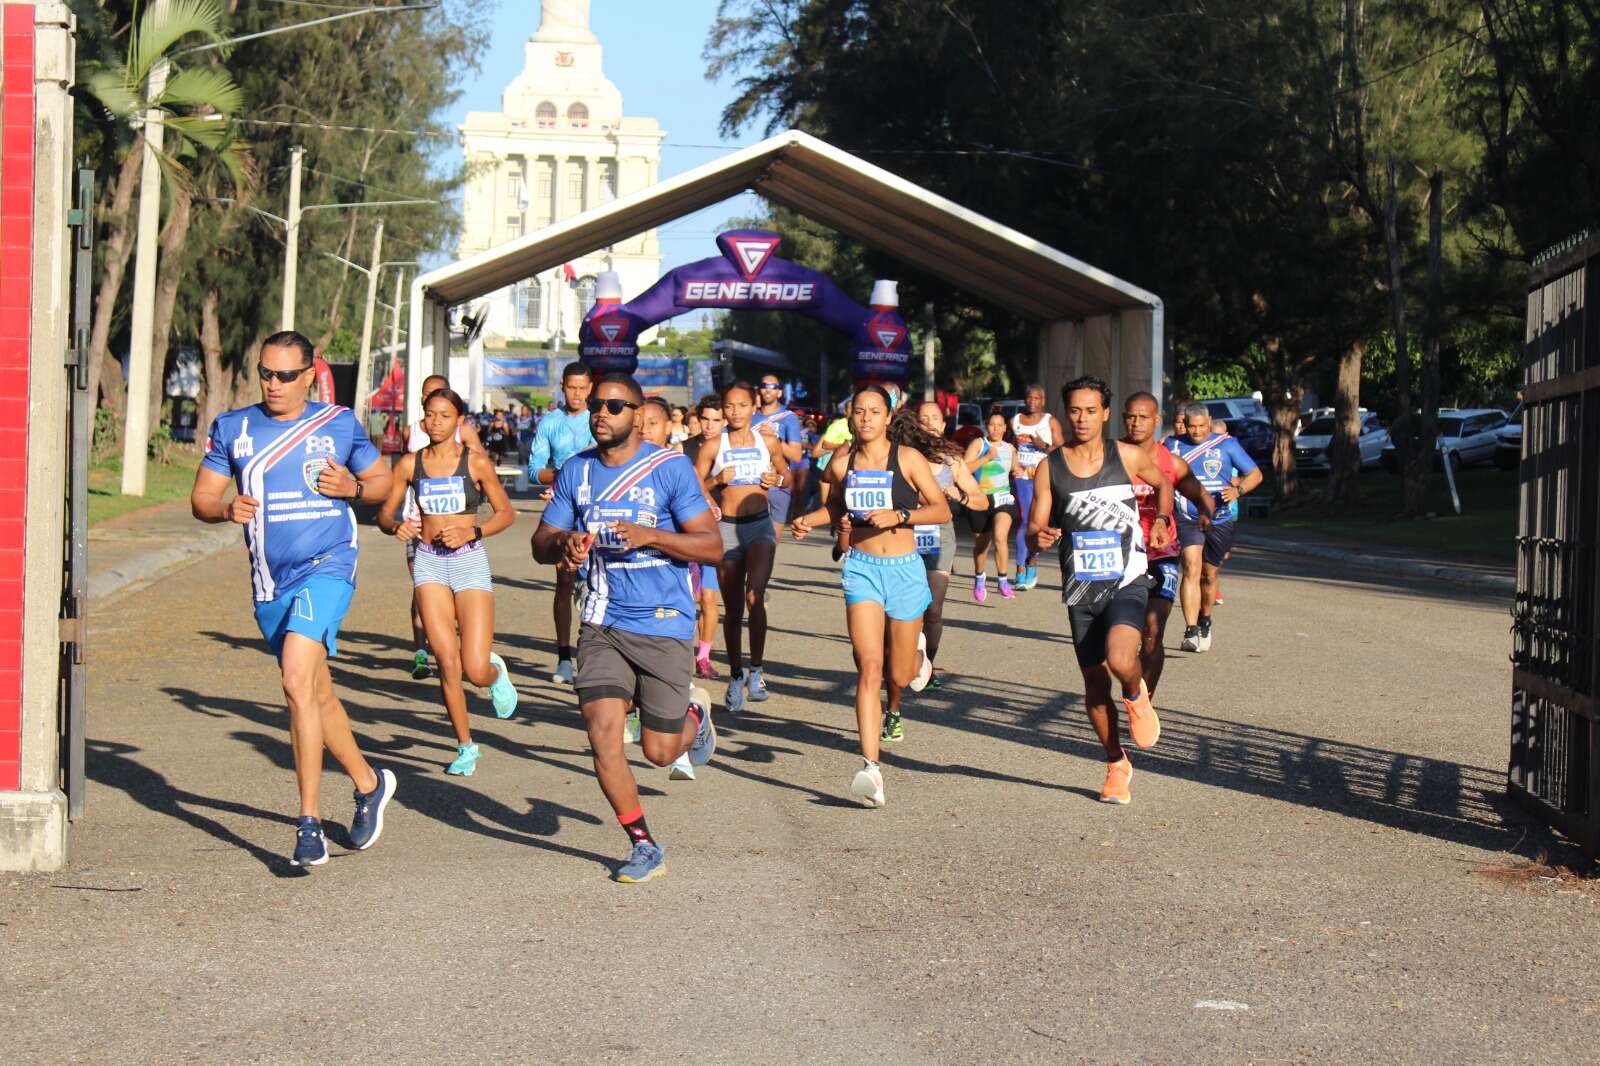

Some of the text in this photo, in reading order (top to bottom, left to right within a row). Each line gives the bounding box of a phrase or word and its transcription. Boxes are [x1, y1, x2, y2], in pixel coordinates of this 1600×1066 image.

[685, 282, 814, 301] GENERADE
[424, 496, 459, 513] 1120
[850, 490, 886, 508] 1109
[1079, 551, 1116, 570] 1213
